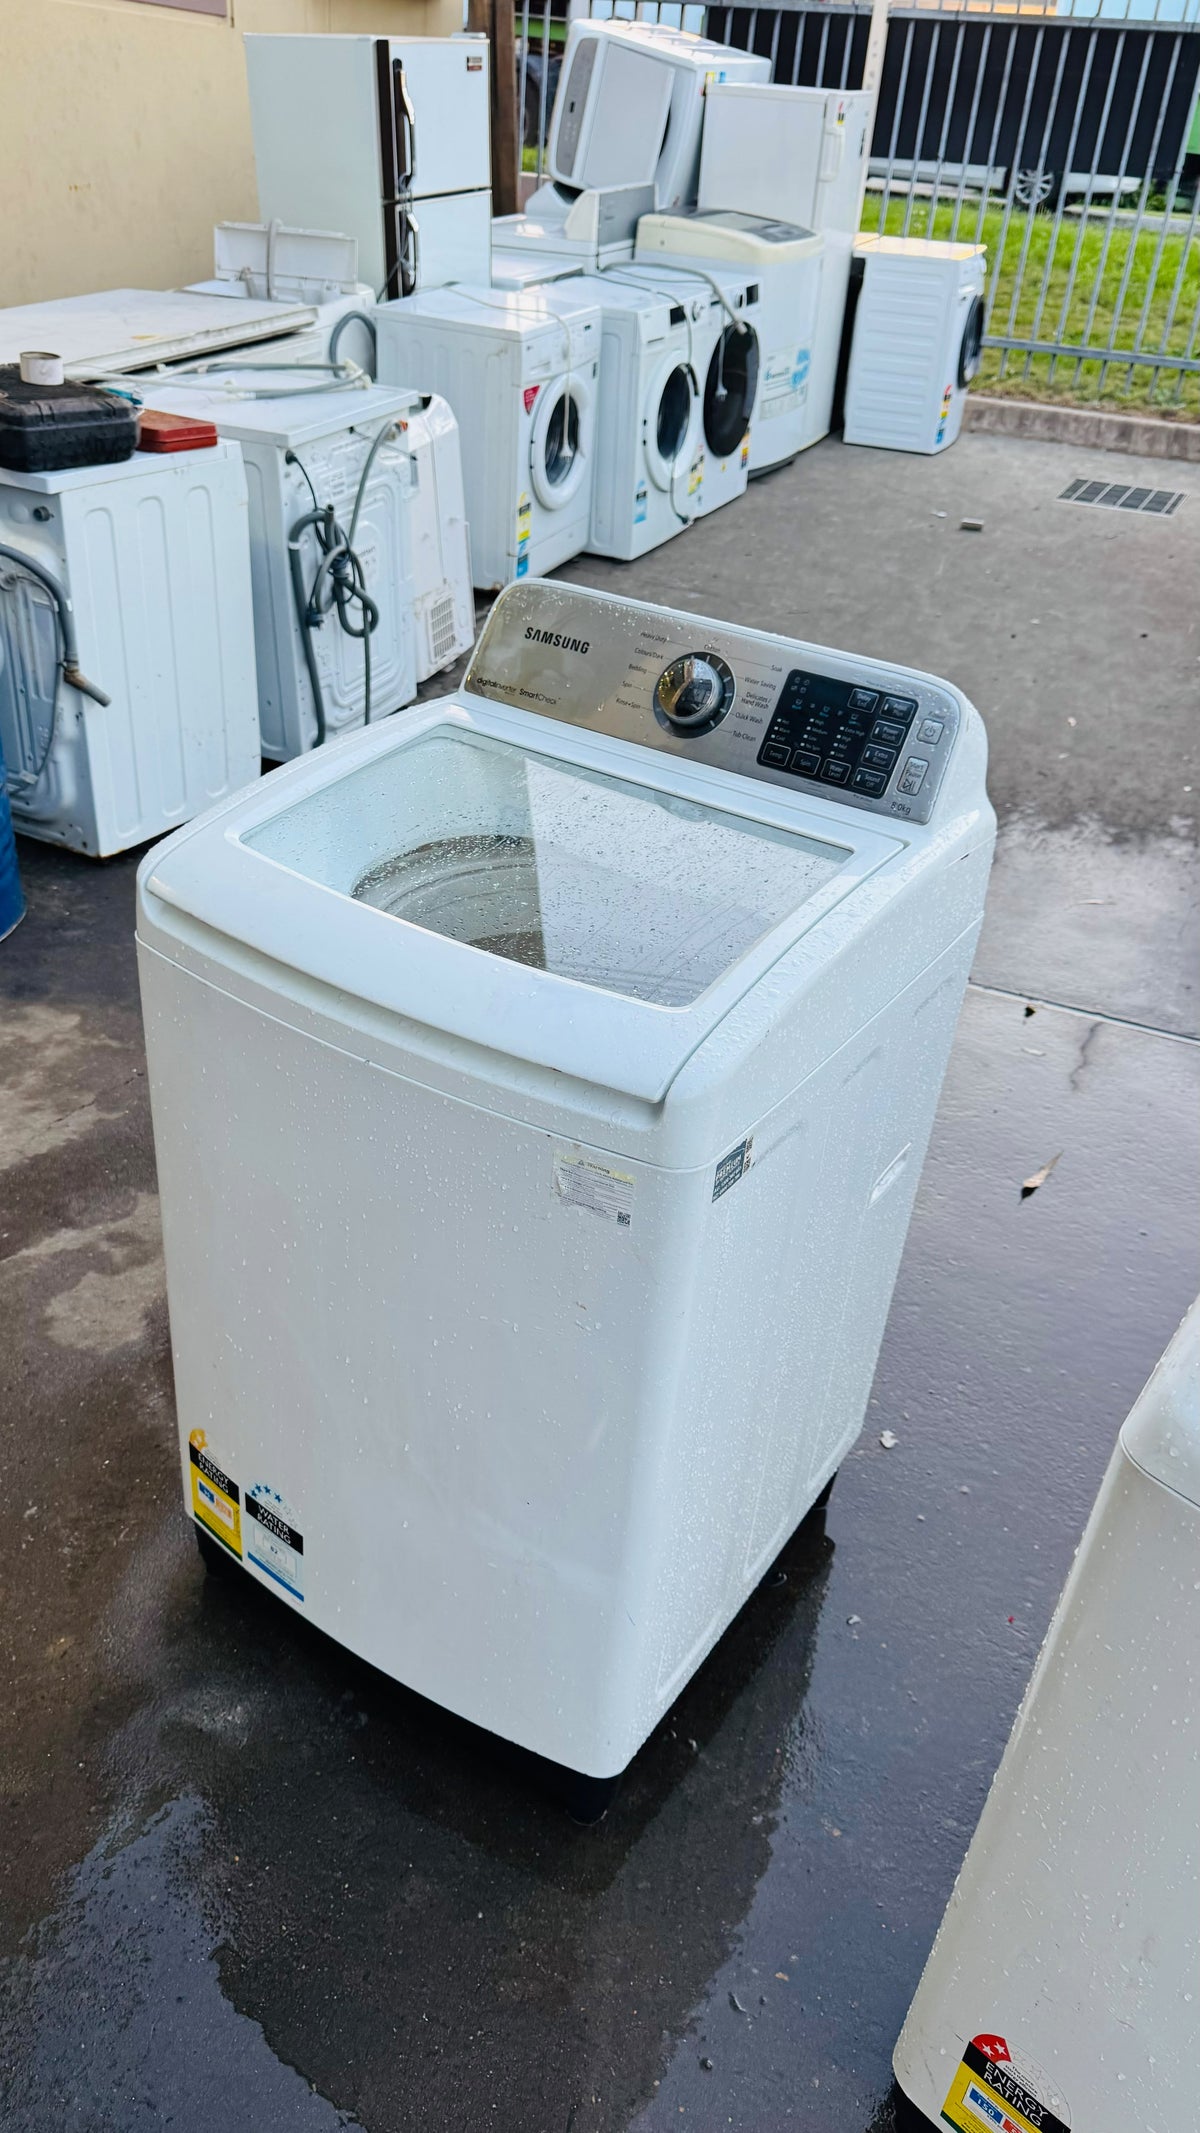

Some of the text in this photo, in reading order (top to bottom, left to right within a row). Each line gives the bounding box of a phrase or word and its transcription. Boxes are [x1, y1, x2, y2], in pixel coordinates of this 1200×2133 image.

[525, 627, 590, 654] SAMSUNG
[704, 644, 720, 652] Cotton
[628, 664, 648, 674] Bedding
[744, 677, 776, 690] Water Saving
[519, 688, 557, 705] SmartCheck
[741, 698, 769, 710] Hand Wash
[746, 691, 766, 702] Delicates
[736, 712, 764, 724] Quick Wash
[732, 730, 756, 742] Tub Clean
[874, 749, 889, 758] Extra
[864, 773, 881, 783] Sound
[198, 1453, 228, 1483] ENERGY
[199, 1462, 228, 1494] RATING
[258, 1504, 290, 1536] WATER
[257, 1514, 290, 1544] RATING
[985, 2062, 1048, 2117] ENERGY
[984, 2071, 1041, 2126] RATING
[977, 2098, 995, 2118] 150
